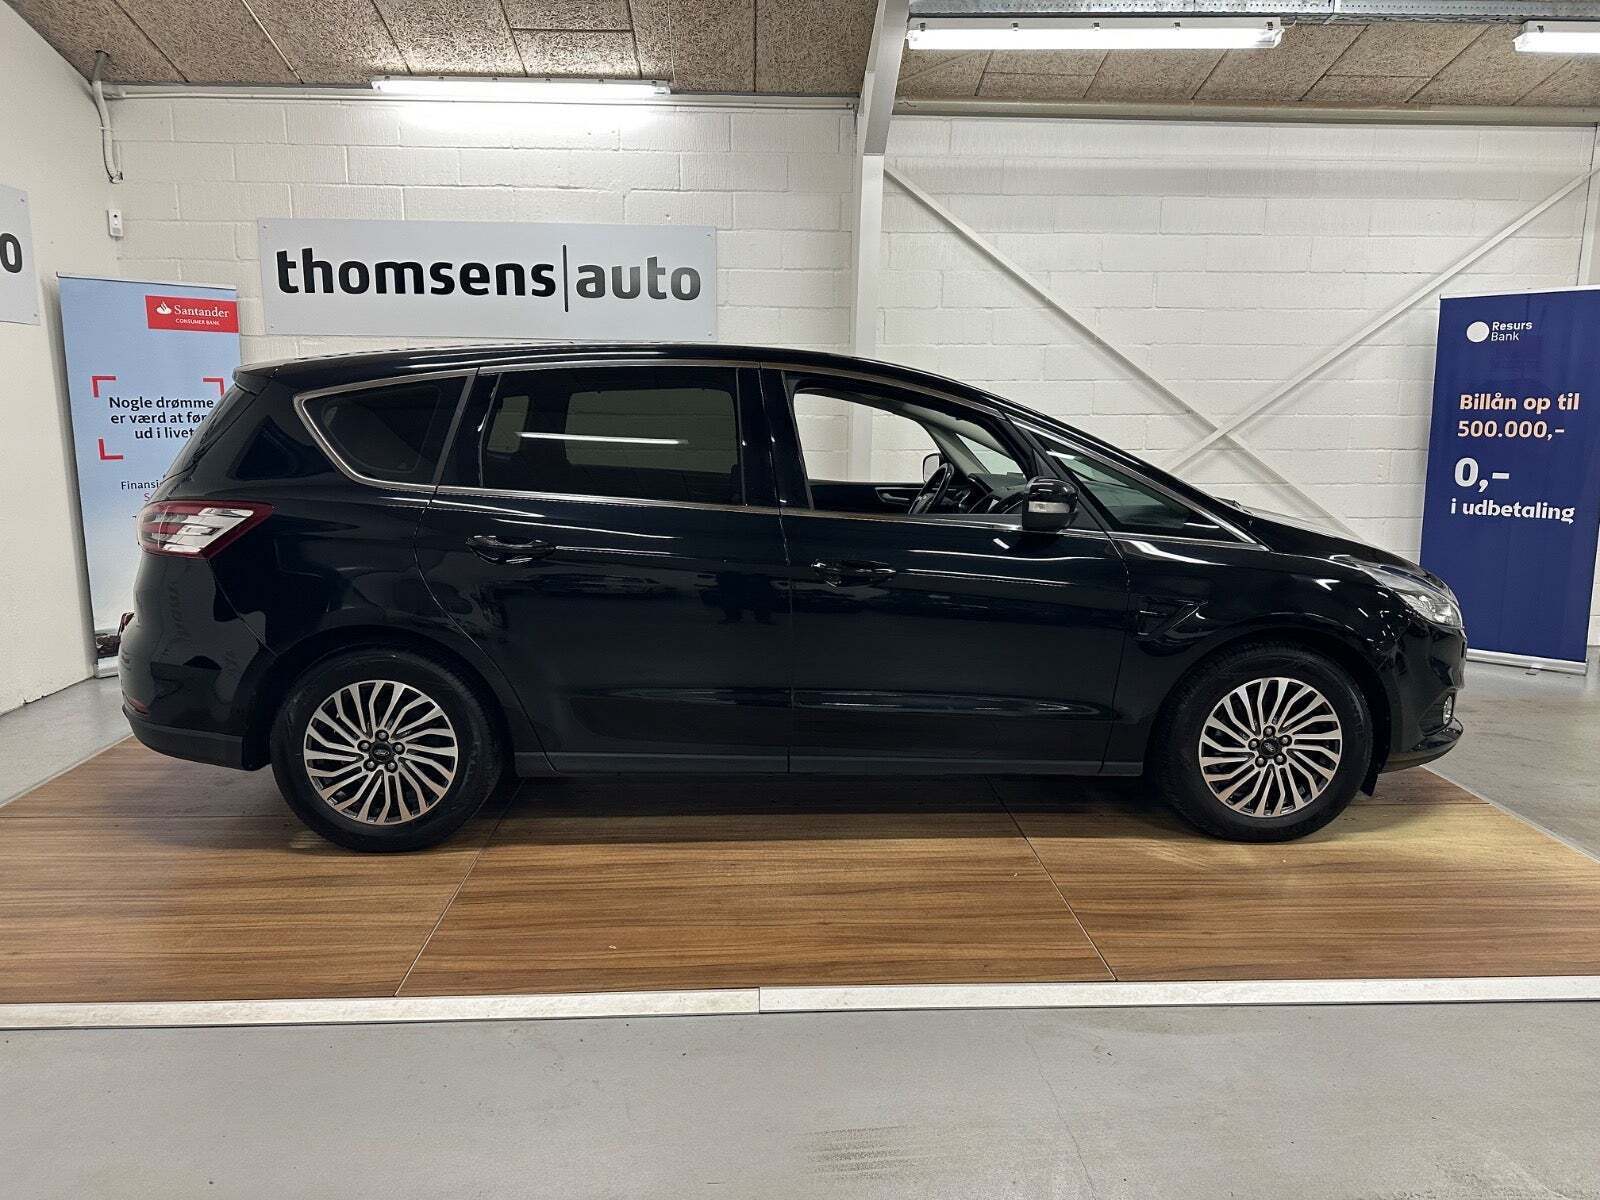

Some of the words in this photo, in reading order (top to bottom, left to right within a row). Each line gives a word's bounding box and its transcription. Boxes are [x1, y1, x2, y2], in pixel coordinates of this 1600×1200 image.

[276, 247, 556, 297] thomsens
[576, 256, 701, 301] auto
[174, 305, 229, 318] Santander
[1492, 321, 1533, 331] Resurs
[1491, 331, 1520, 341] Bank
[109, 396, 153, 412] Nogle
[156, 396, 214, 409] drømme
[1460, 392, 1517, 410] Billån
[1523, 397, 1551, 414] op
[1558, 392, 1580, 410] til
[110, 415, 125, 424] er
[130, 412, 167, 424] værd
[169, 413, 184, 424] at
[135, 426, 153, 439] ud
[157, 426, 161, 439] i
[121, 480, 160, 490] Finansi
[1450, 497, 1457, 515] i
[1462, 499, 1576, 525] udbetaling
